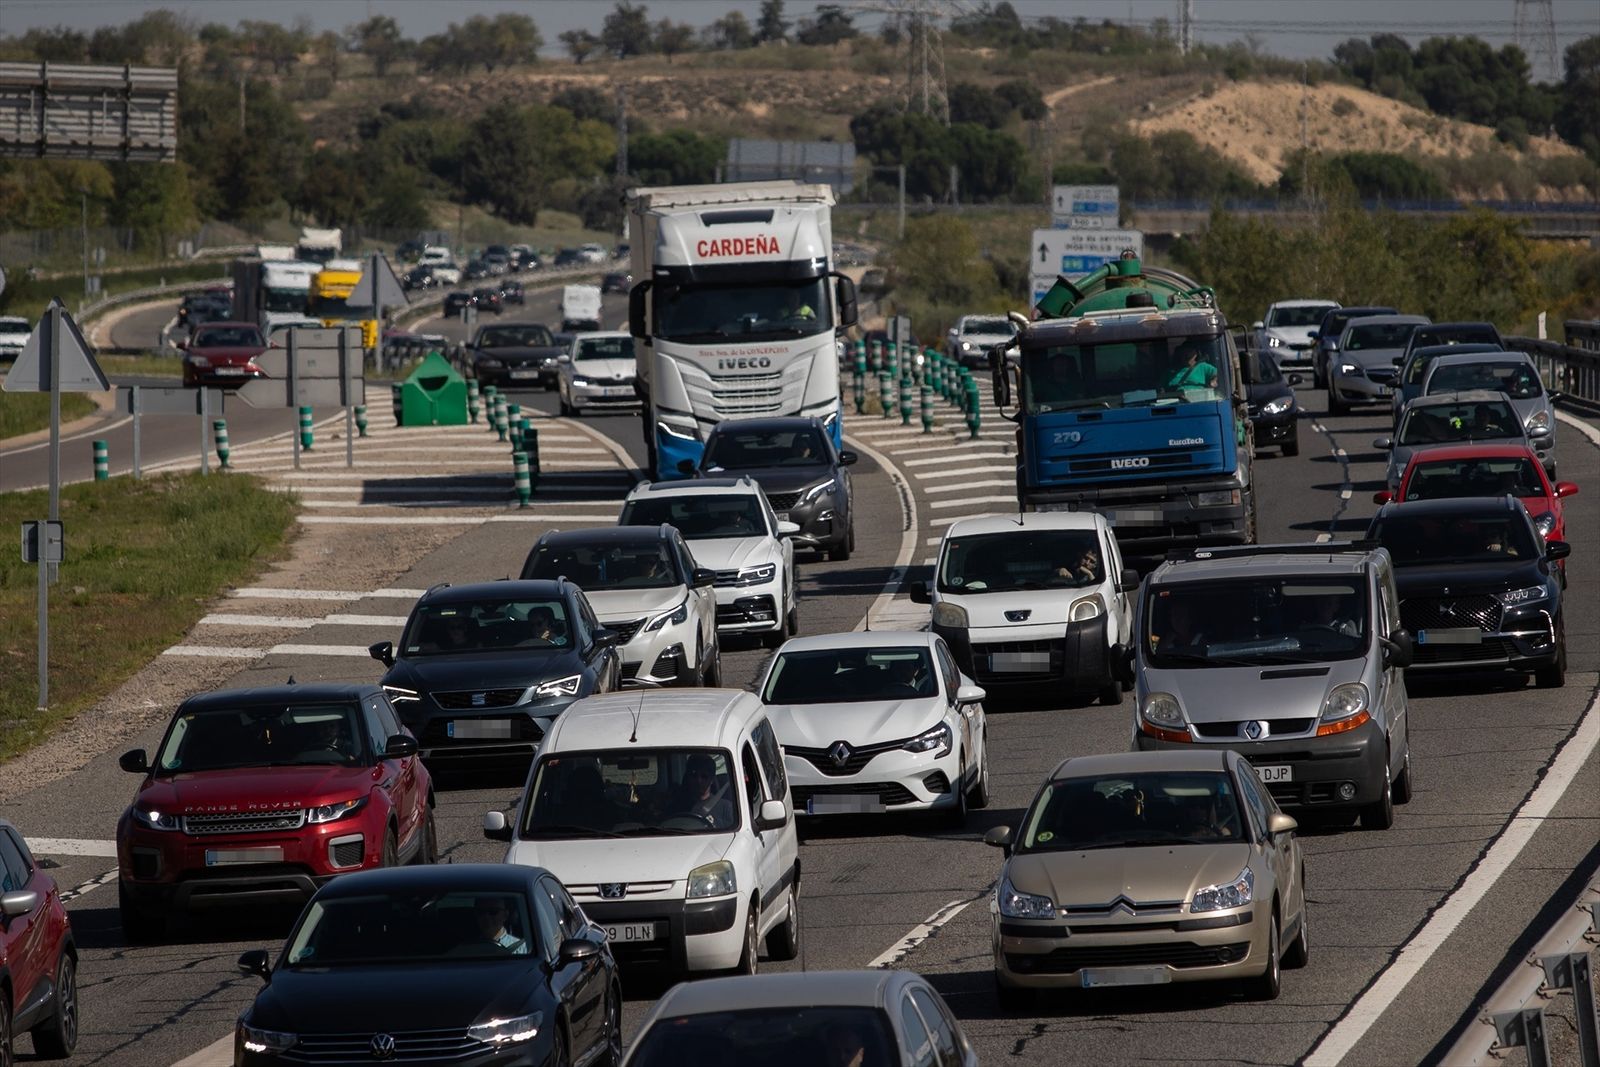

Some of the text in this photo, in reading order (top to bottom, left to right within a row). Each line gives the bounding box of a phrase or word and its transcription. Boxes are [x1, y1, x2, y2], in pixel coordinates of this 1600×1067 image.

[697, 234, 780, 258] CARDEÑA
[718, 357, 771, 369] IVECO
[1053, 431, 1081, 444] 270
[1110, 457, 1150, 469] IVECO
[1264, 767, 1288, 780] DJP
[248, 801, 301, 809] ROVER
[625, 926, 650, 940] DLN
